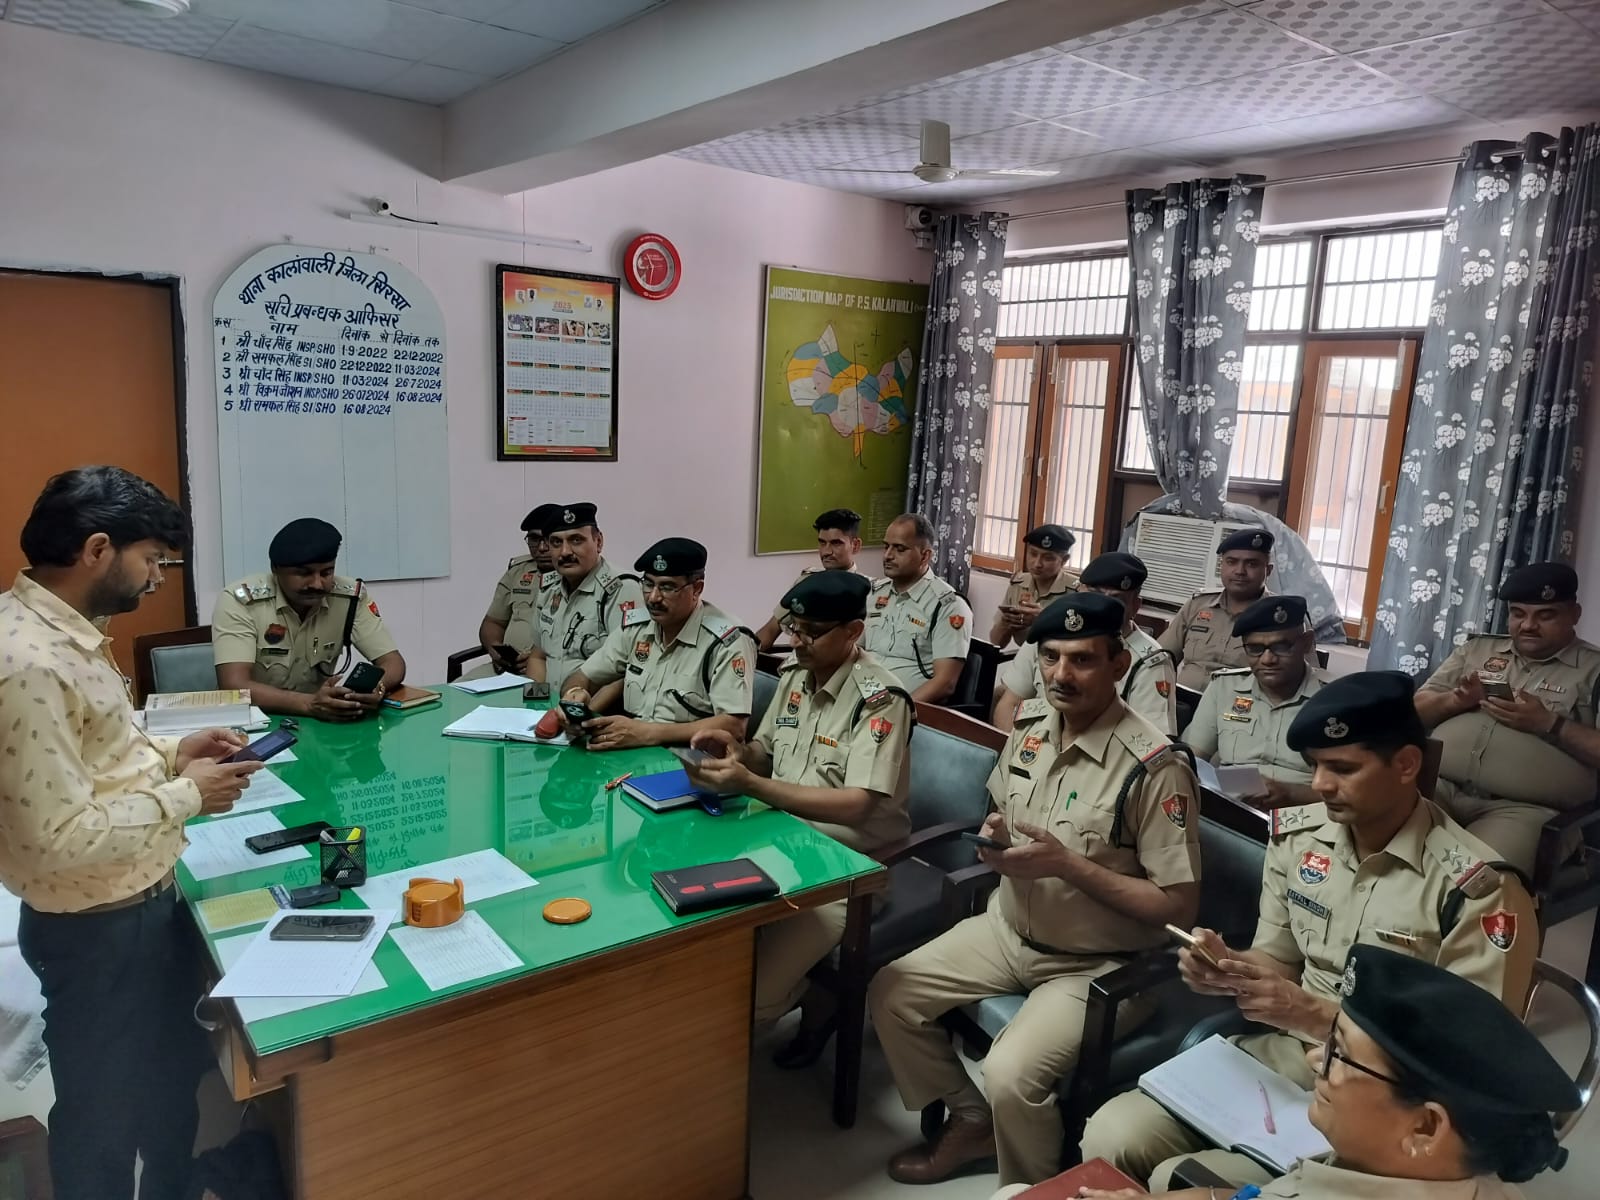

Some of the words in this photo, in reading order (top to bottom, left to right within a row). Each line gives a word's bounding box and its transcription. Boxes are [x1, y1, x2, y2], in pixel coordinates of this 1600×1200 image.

[238, 274, 266, 305] थाना
[335, 256, 369, 285] जिला
[366, 271, 412, 311] सिरसा
[770, 286, 824, 304] JURISDICTION
[825, 292, 842, 306] MAP
[845, 295, 855, 307] OF
[269, 322, 300, 335] नाम
[221, 335, 226, 346] 1
[341, 325, 371, 341] दिनांक
[392, 329, 420, 346] दिनांक
[424, 336, 440, 347] तक
[222, 352, 231, 361] 2
[222, 367, 231, 379] 3
[224, 384, 233, 396] 4
[223, 400, 233, 411] 5
